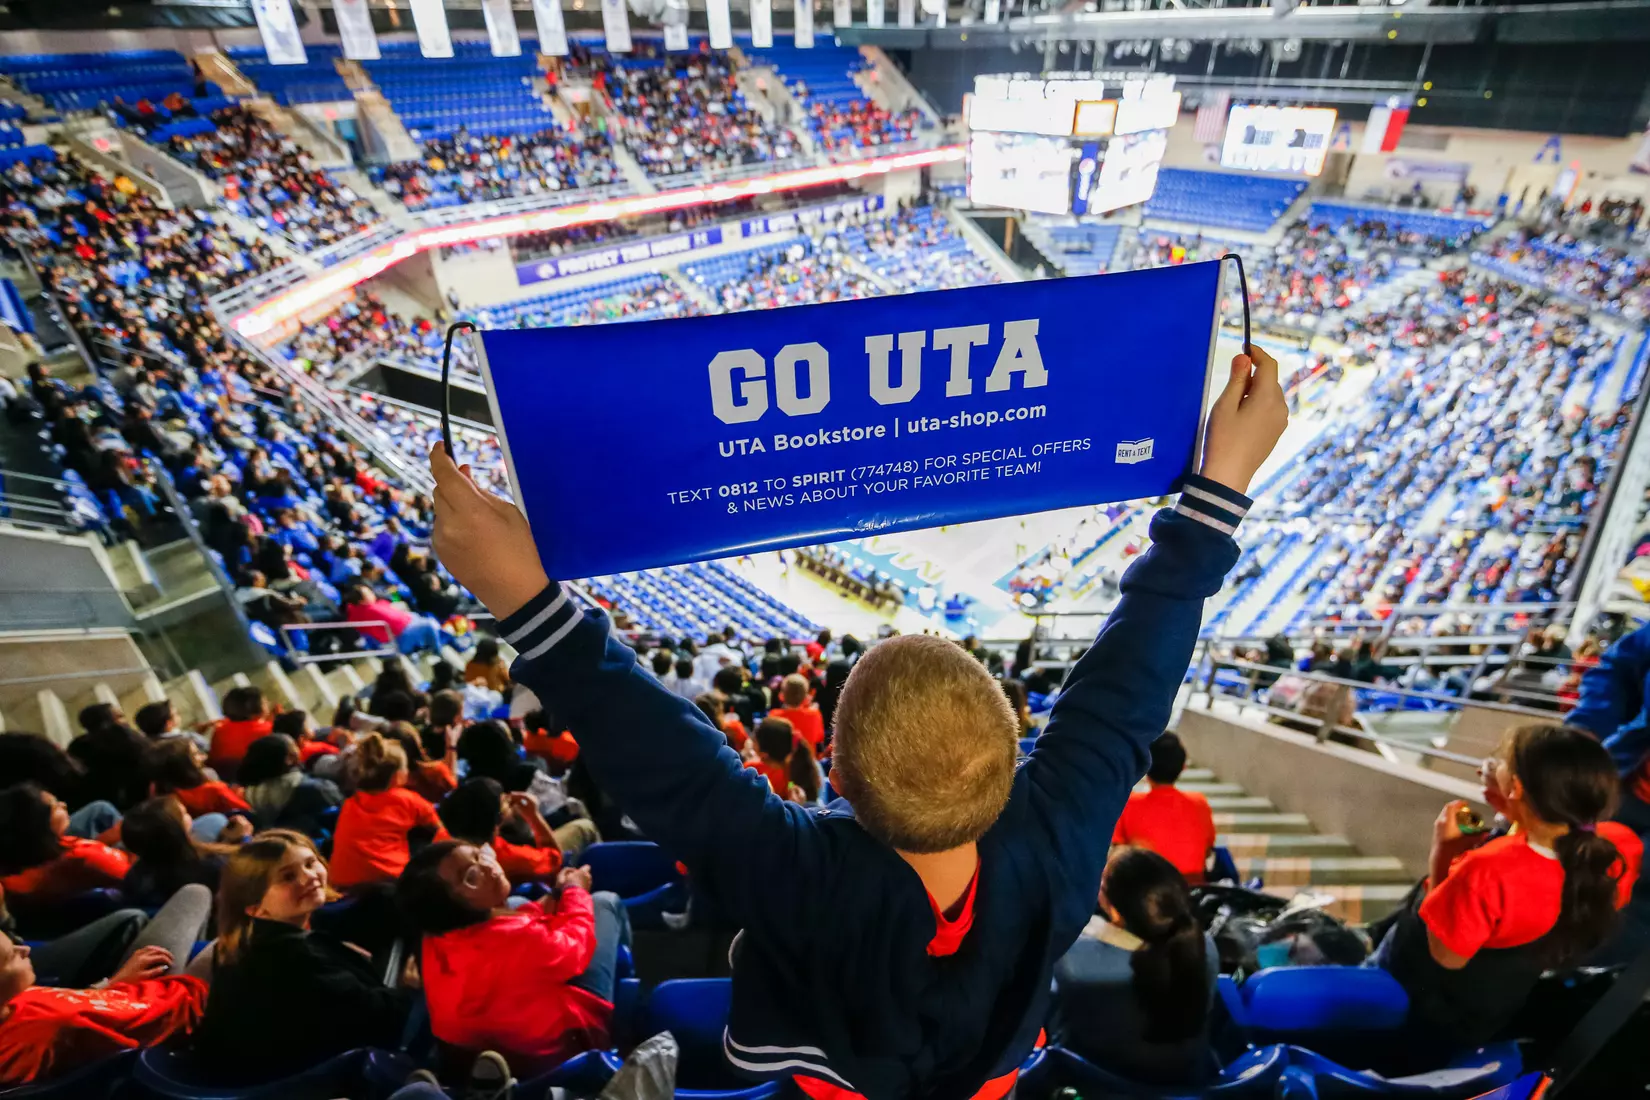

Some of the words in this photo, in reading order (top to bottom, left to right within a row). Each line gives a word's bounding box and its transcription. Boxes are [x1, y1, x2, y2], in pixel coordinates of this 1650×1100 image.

[708, 342, 830, 424] GO
[865, 319, 1048, 405] UTA
[719, 438, 766, 457] UTA
[774, 425, 886, 450] Bookstore
[908, 405, 1047, 433] uta-shop.com
[1117, 449, 1132, 458] RENT
[1137, 445, 1151, 457] TEXT
[667, 488, 712, 504] TEXT
[719, 482, 758, 498] 0812
[764, 478, 787, 491] TO
[793, 470, 846, 487] SPIRIT
[851, 460, 919, 481] (774748)
[925, 456, 957, 470] FOR
[963, 447, 1027, 465] SPECIAL
[1032, 438, 1091, 456] OFFERS
[727, 502, 739, 514] &
[744, 494, 795, 511] NEWS
[800, 485, 858, 504] ABOUT
[864, 479, 908, 494] YOUR
[914, 468, 990, 489] FAVORITE
[995, 461, 1041, 478] TEAM!
